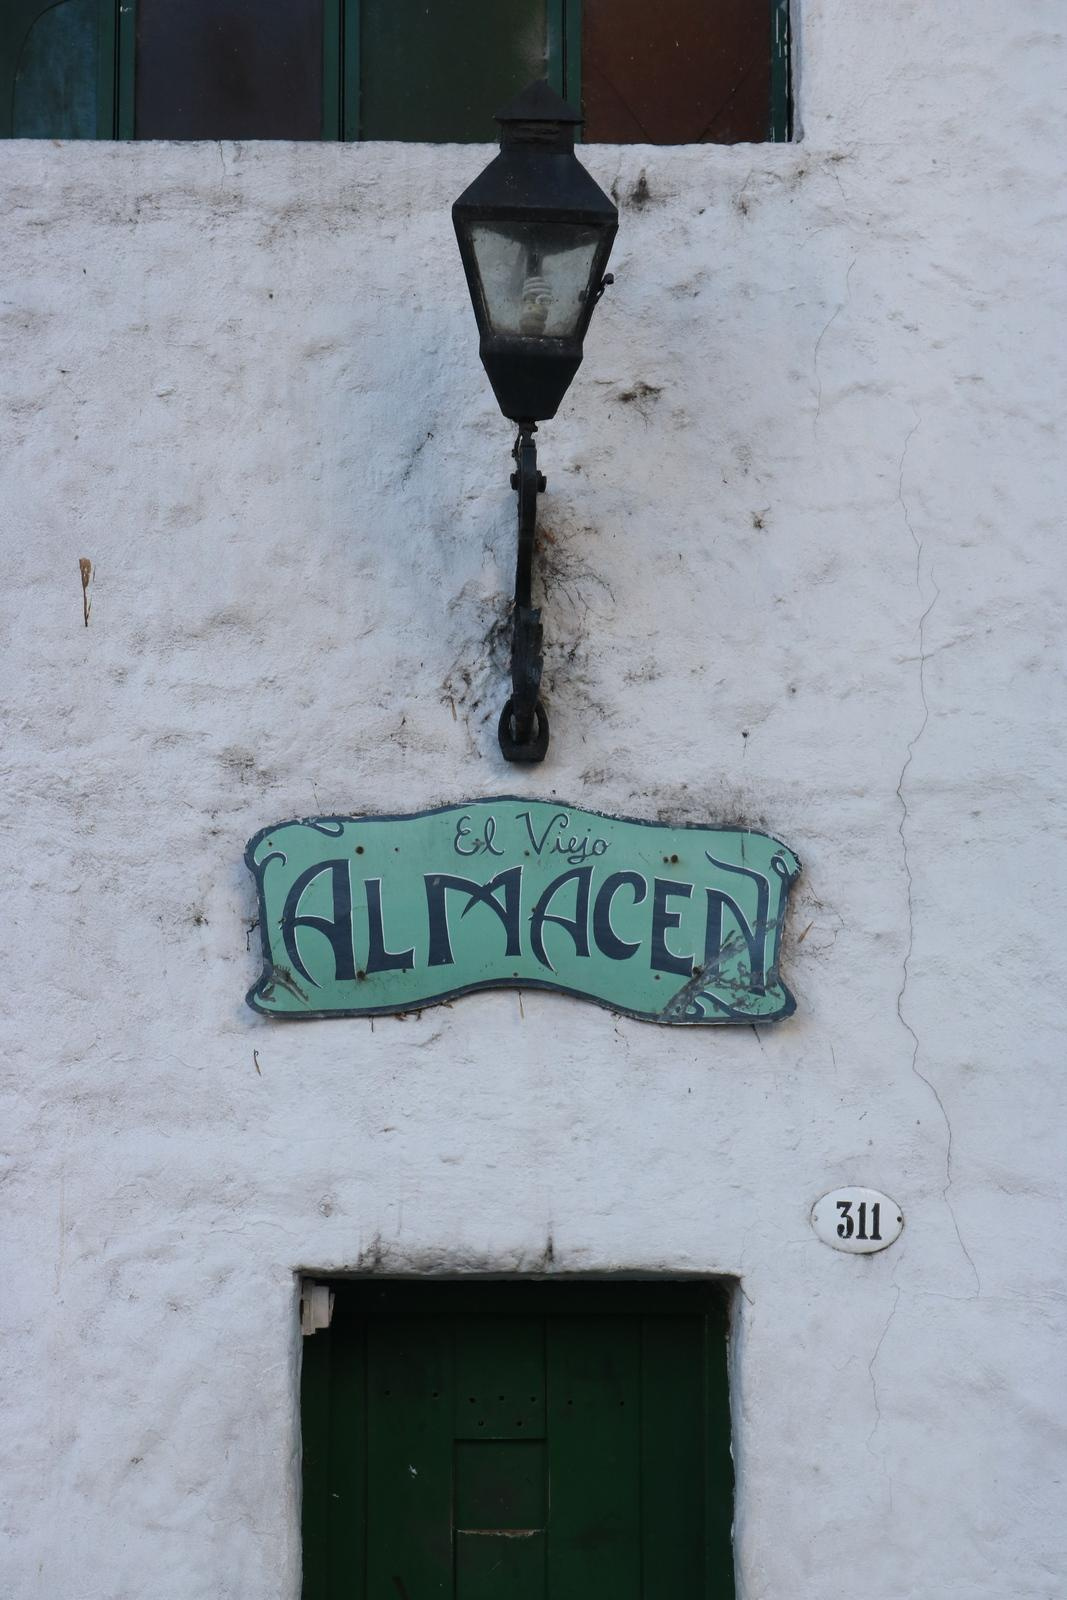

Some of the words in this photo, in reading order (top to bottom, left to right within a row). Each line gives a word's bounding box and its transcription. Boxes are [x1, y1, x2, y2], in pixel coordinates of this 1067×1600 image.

[453, 815, 505, 856] El
[516, 812, 612, 864] Viejo
[279, 849, 770, 997] ALMACEN
[836, 1201, 882, 1241] 311
